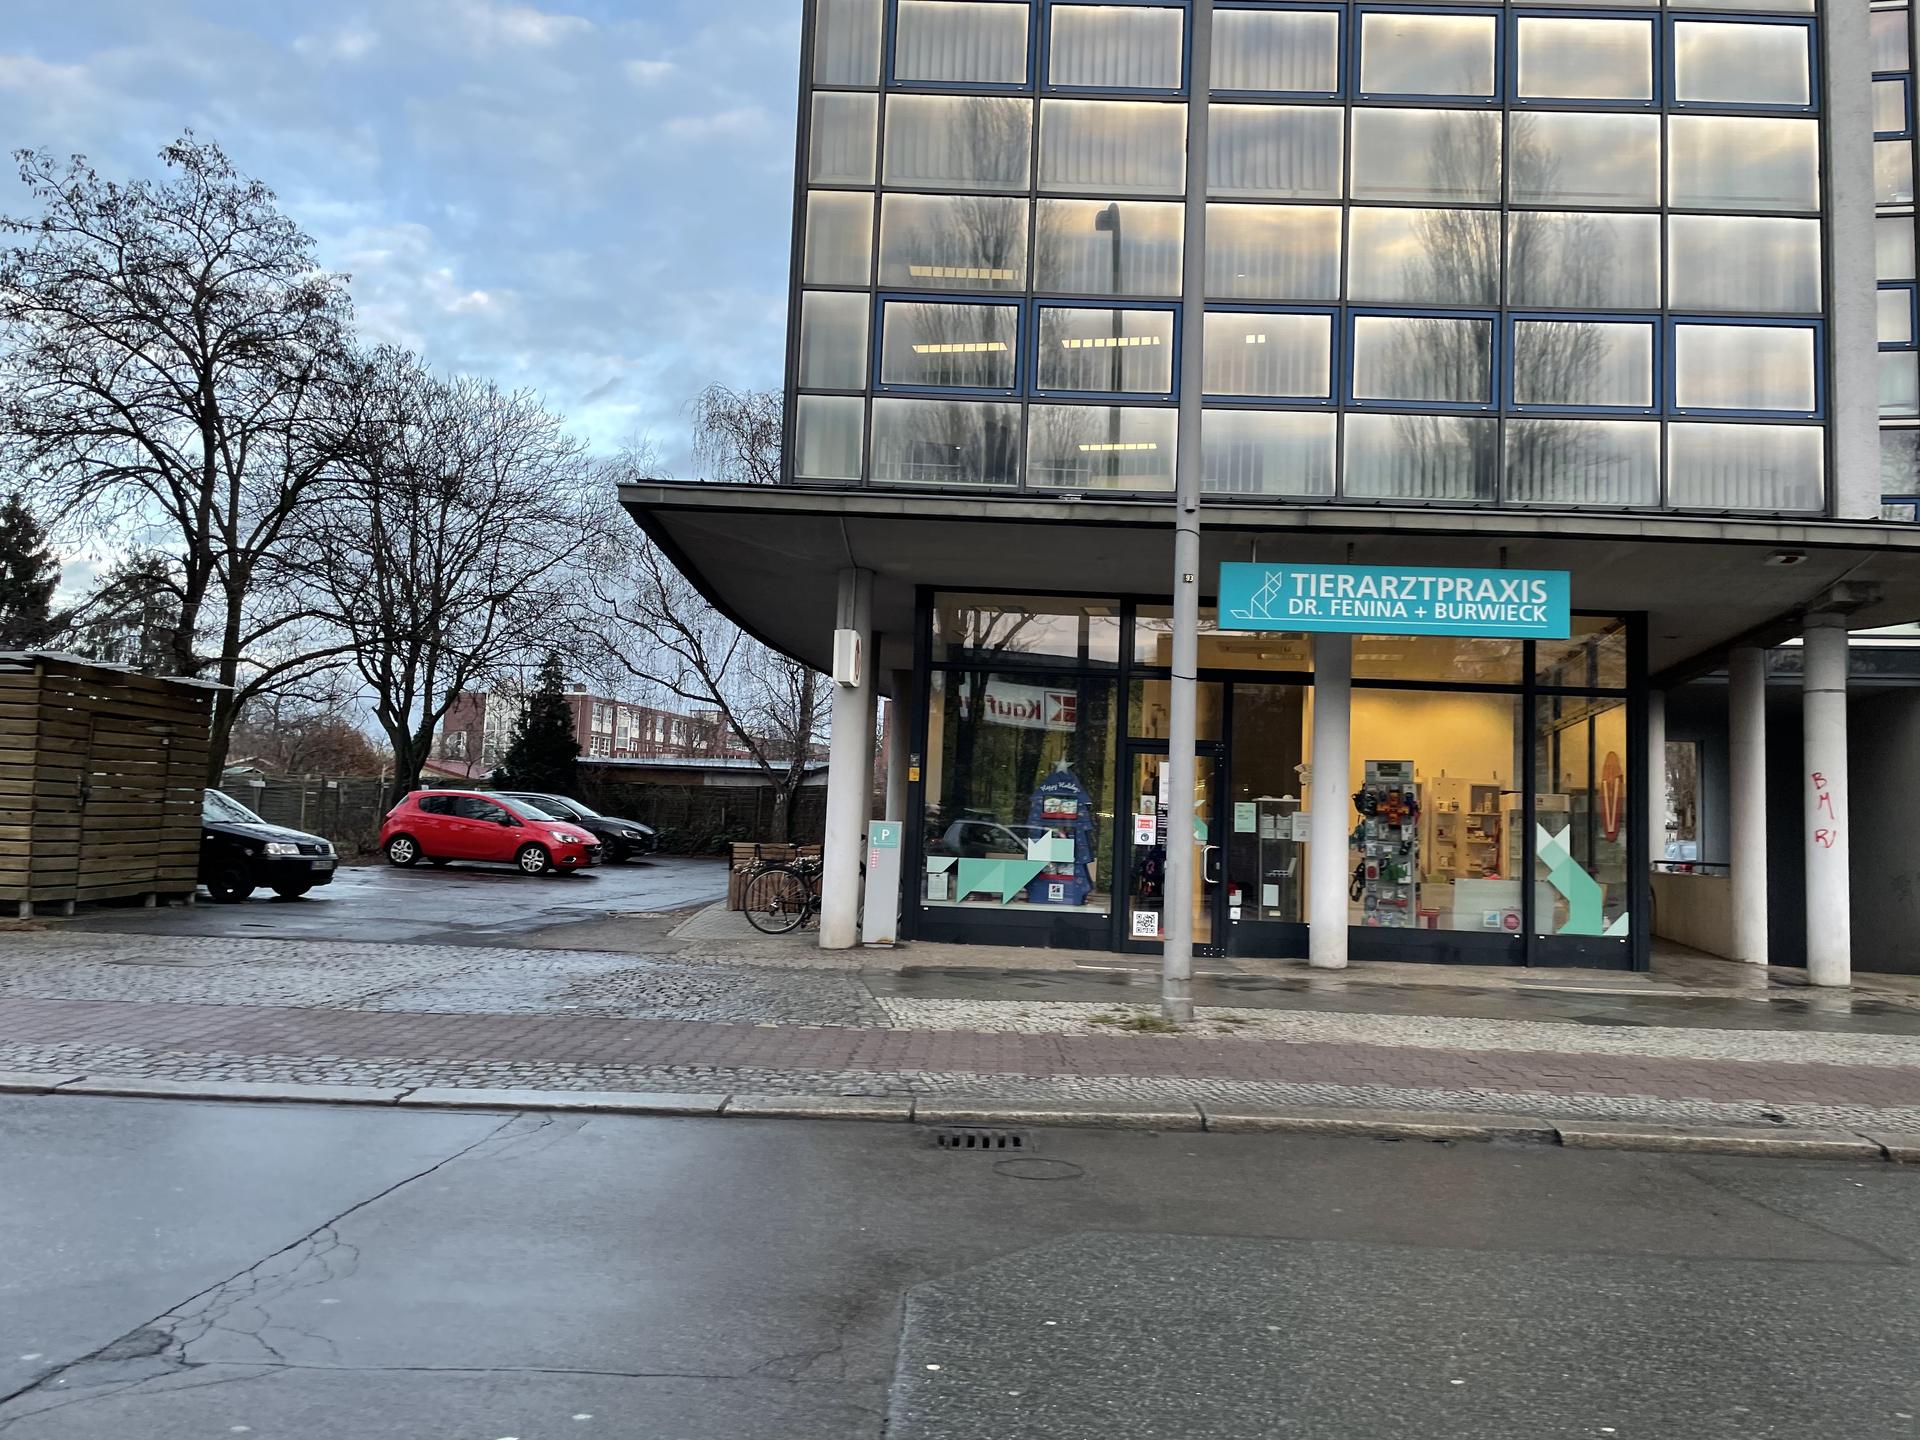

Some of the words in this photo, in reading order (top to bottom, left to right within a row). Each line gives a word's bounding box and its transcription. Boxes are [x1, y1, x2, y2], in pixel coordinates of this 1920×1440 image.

[1290, 573, 1548, 604] TIERARZTPRAXIS
[1288, 598, 1323, 615] DR.
[1330, 599, 1408, 618] FENINA
[1414, 606, 1428, 618] +
[1434, 602, 1548, 622] BURWIECK
[881, 829, 890, 841] P
